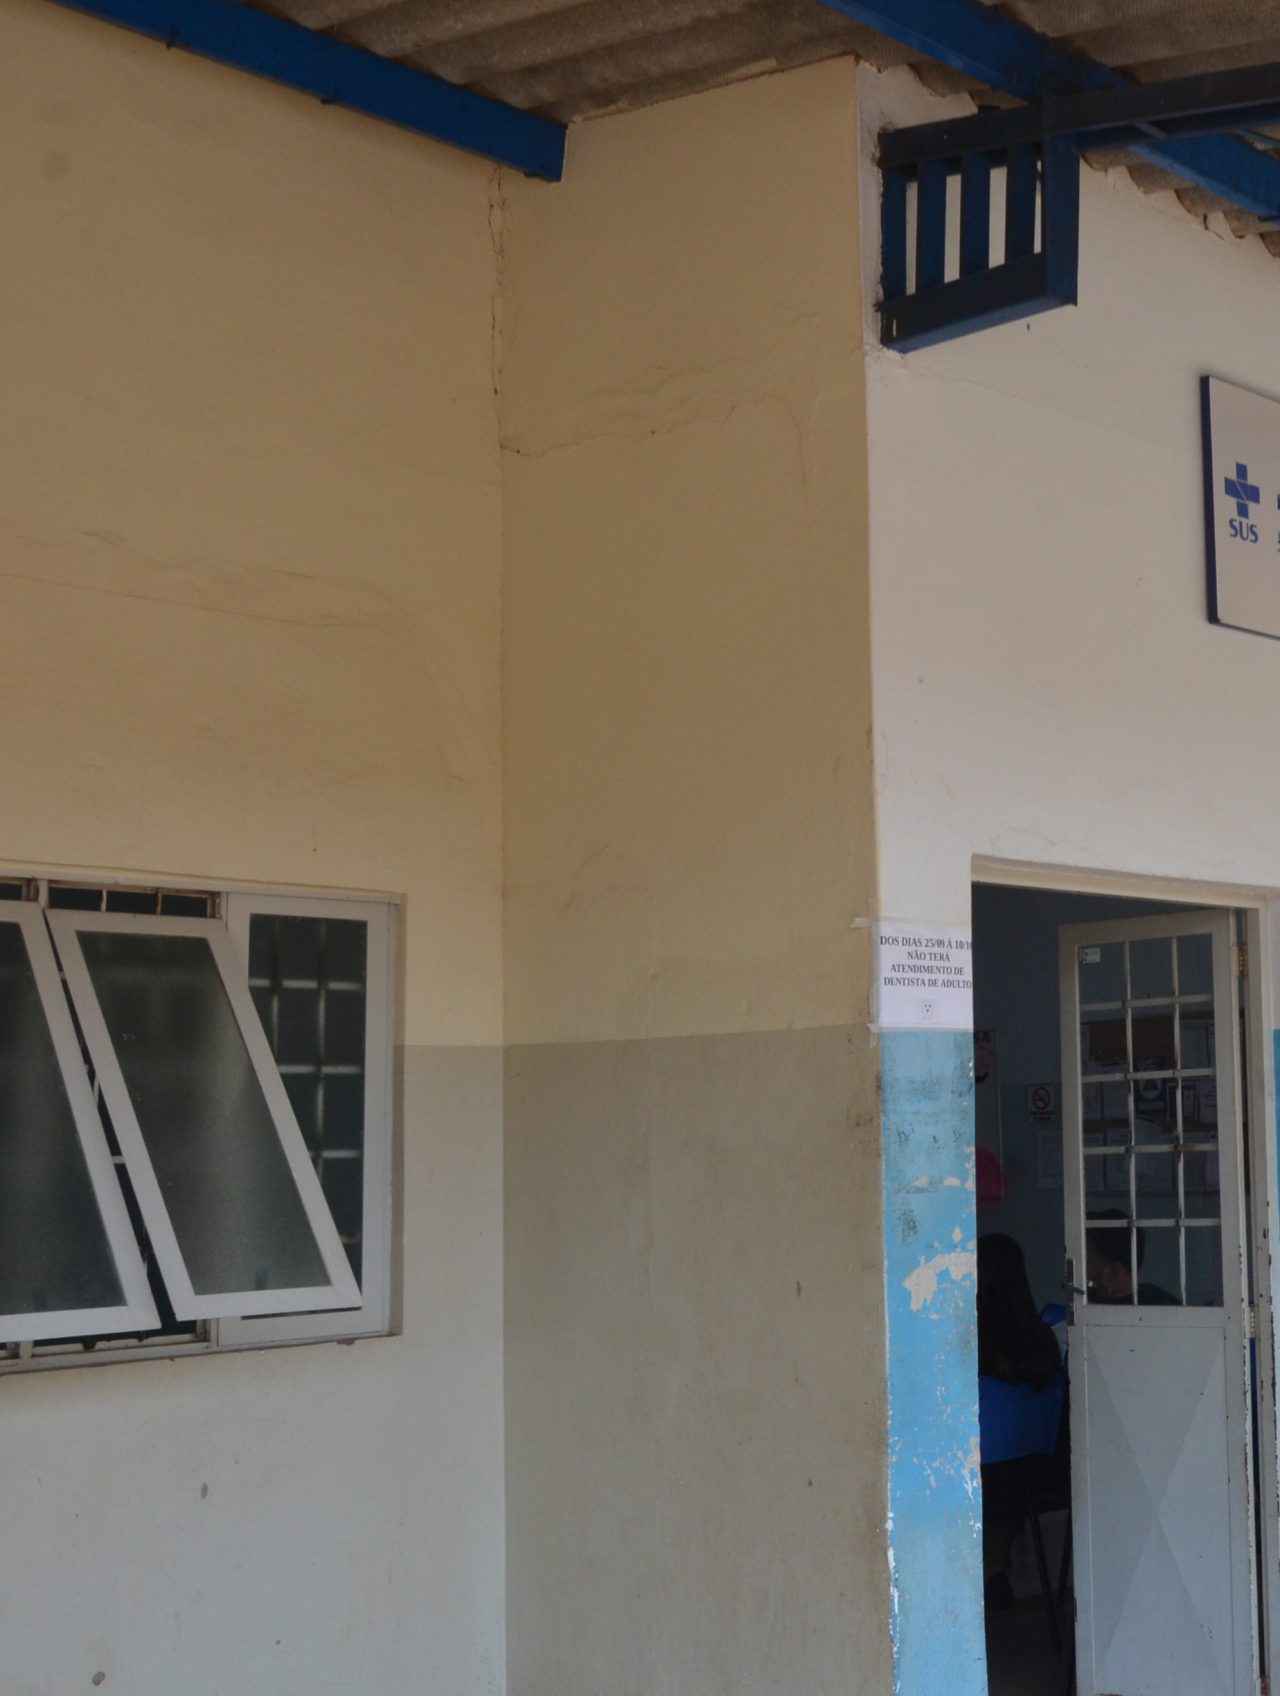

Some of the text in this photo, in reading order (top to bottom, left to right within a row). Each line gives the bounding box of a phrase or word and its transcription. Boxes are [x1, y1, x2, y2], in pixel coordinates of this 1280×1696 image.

[1229, 518, 1259, 544] SUS
[880, 935, 899, 946] DOS
[902, 937, 923, 948] DIAS
[907, 949, 950, 962] NÃO TERÁ
[890, 964, 965, 976] ATENDIMENTO DE
[883, 977, 926, 988] DENTISTA
[928, 978, 939, 988] DE
